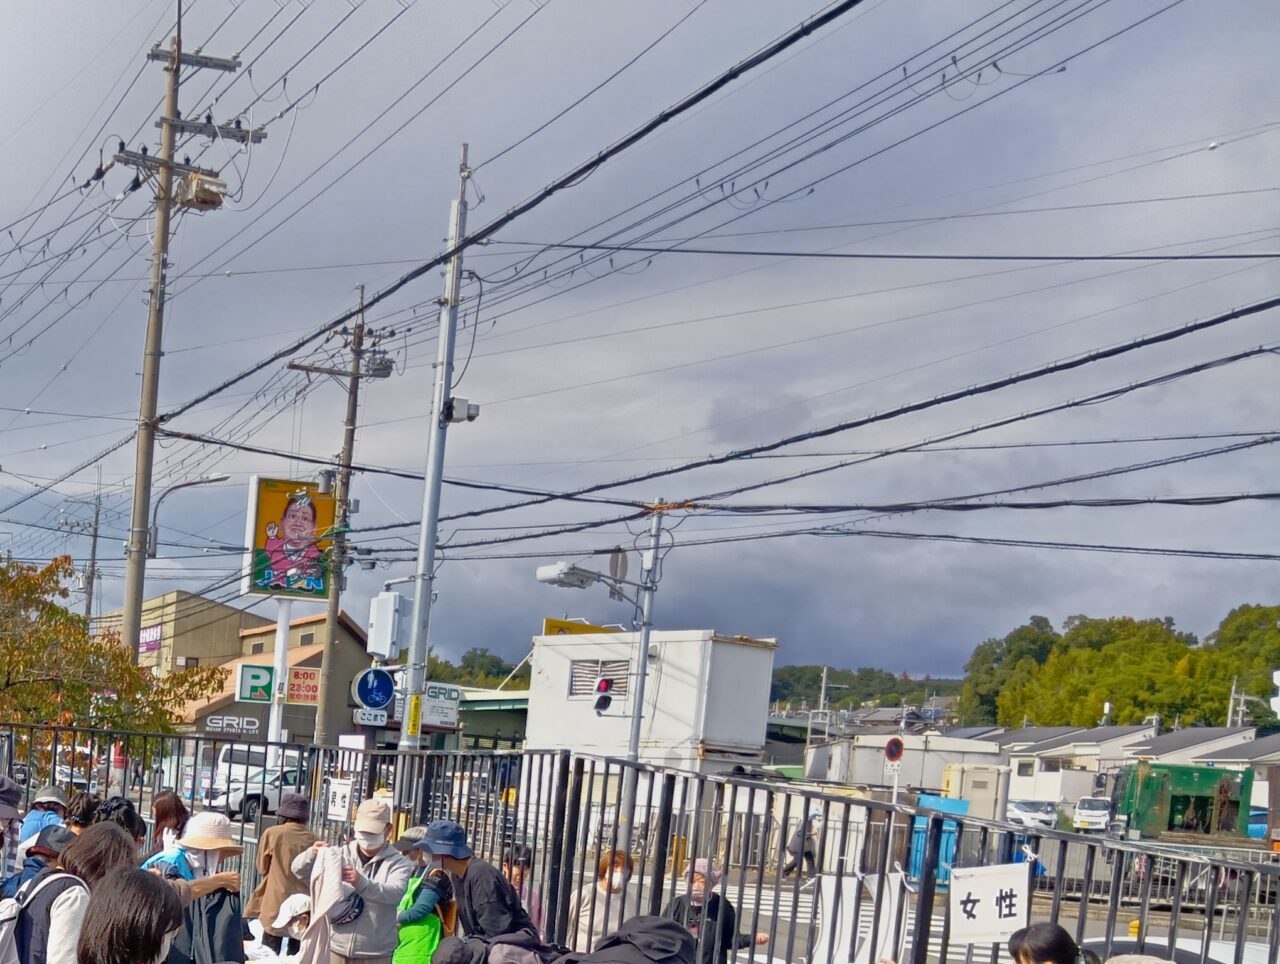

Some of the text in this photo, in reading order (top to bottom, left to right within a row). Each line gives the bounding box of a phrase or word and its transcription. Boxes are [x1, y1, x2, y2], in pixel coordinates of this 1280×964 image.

[241, 667, 270, 698] P
[293, 671, 316, 681] 8:00
[427, 686, 459, 700] GRID
[206, 715, 259, 729] GRID
[360, 712, 385, 722] ここまで
[959, 887, 1018, 920] 女性
